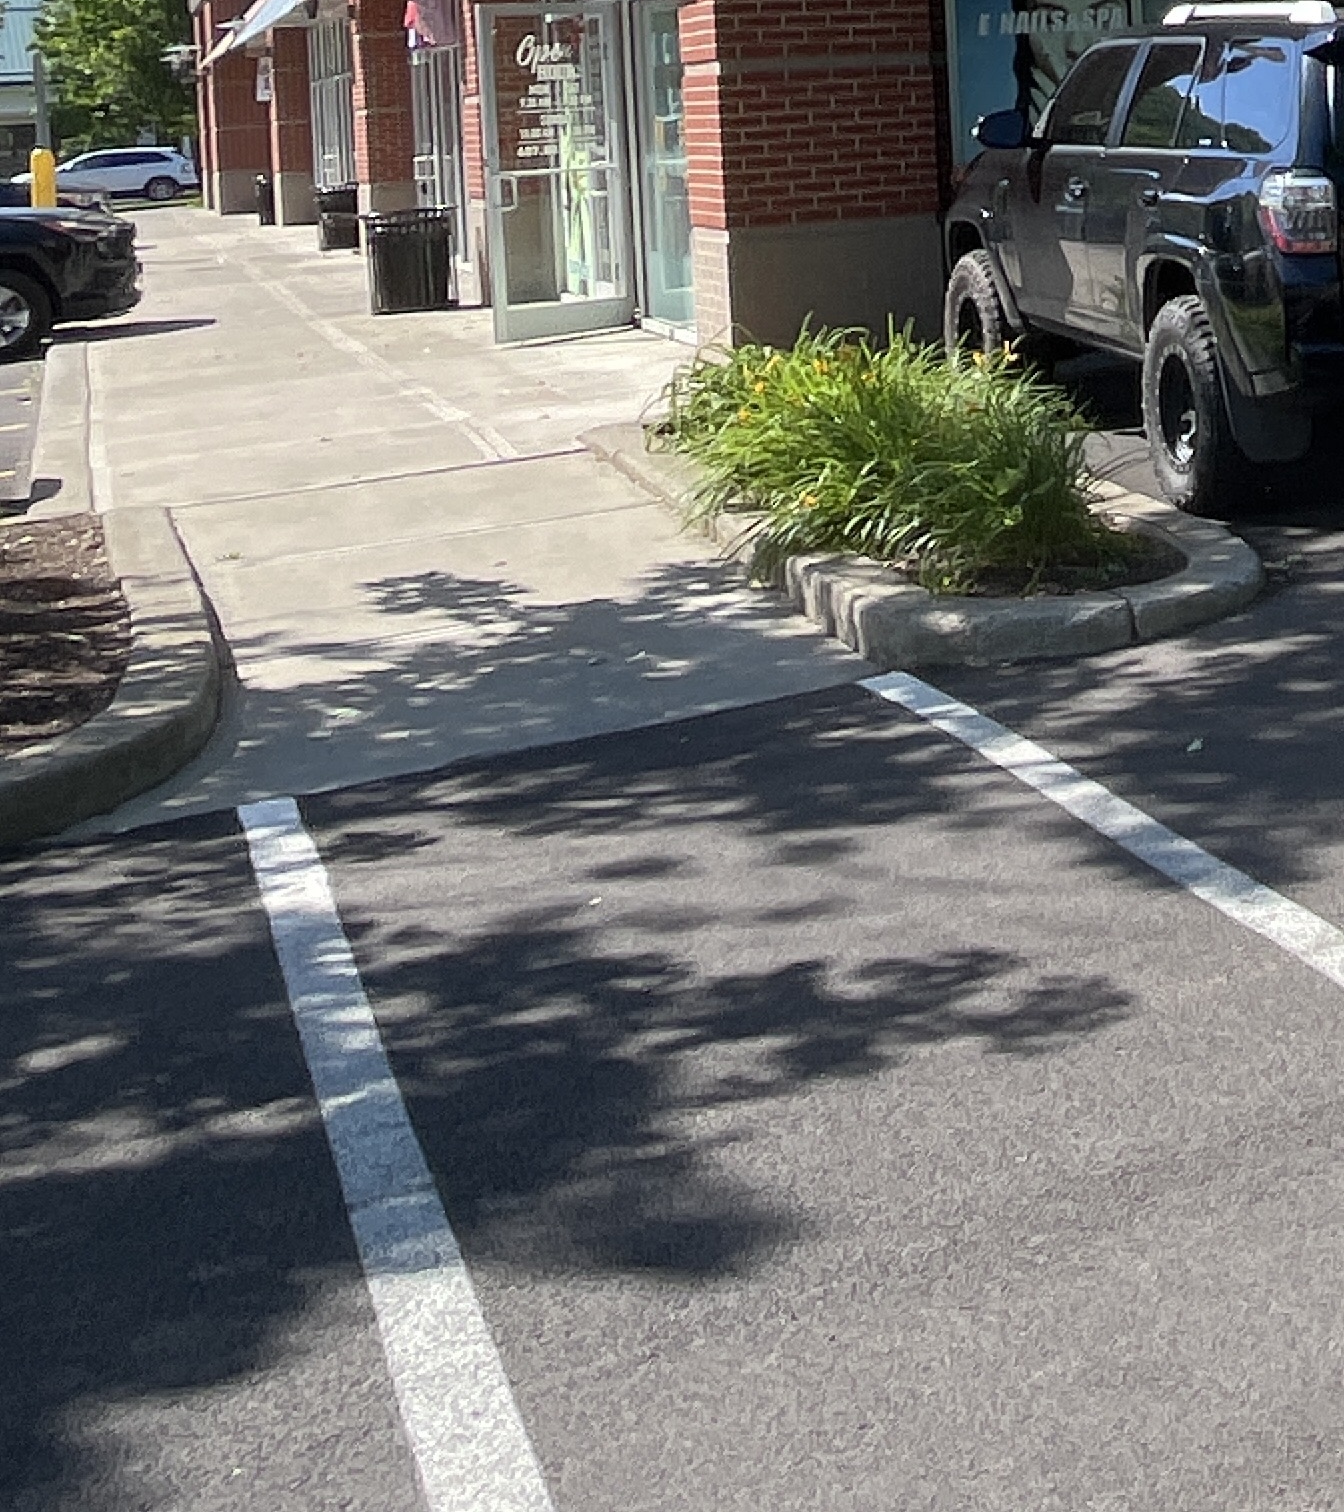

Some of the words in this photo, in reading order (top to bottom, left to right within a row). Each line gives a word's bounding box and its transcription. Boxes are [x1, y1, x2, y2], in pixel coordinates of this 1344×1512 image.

[977, 12, 991, 37] E
[1000, 8, 1126, 35] NAILS&SPA
[516, 34, 572, 74] Open
